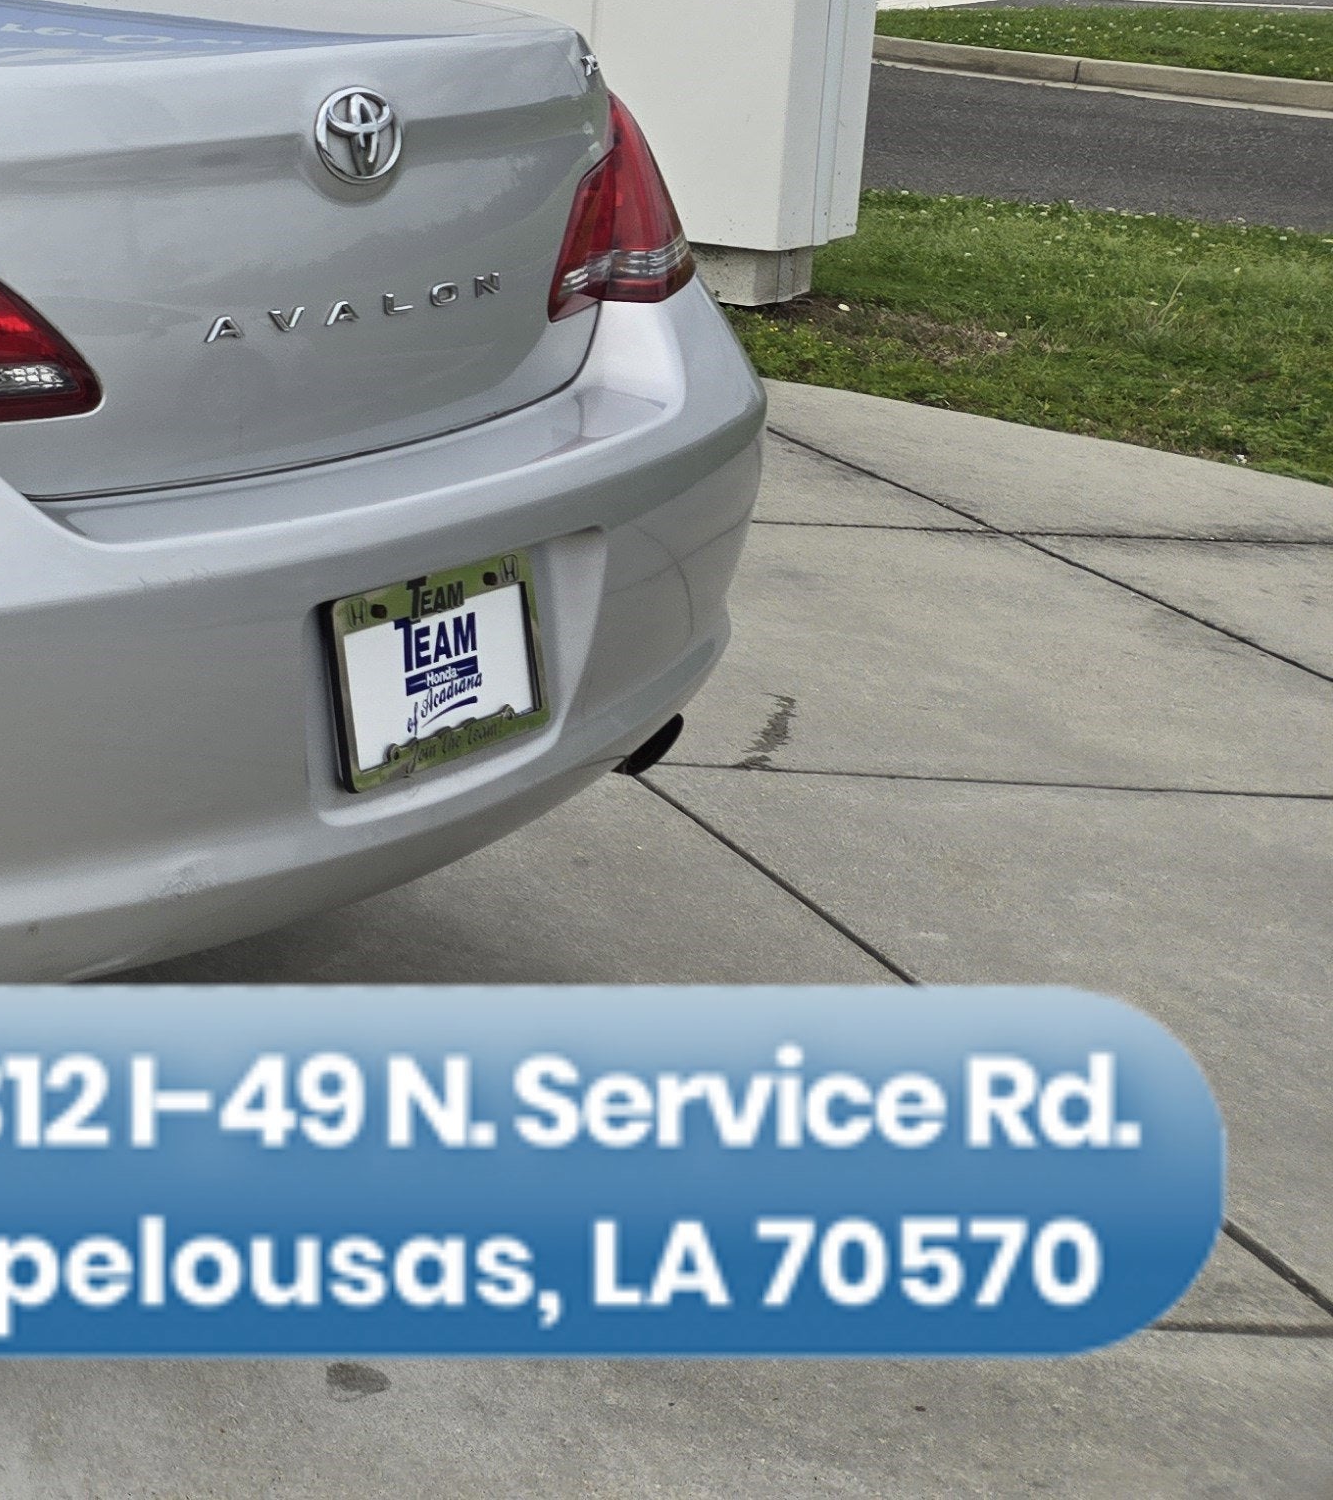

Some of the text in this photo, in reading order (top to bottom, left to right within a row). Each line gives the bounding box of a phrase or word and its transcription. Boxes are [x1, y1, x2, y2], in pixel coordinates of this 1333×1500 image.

[204, 271, 501, 344] AVALON
[406, 576, 465, 621] TEAM
[393, 612, 478, 673] TEAM
[407, 673, 483, 738] of Acadiana
[425, 666, 460, 687] Honda
